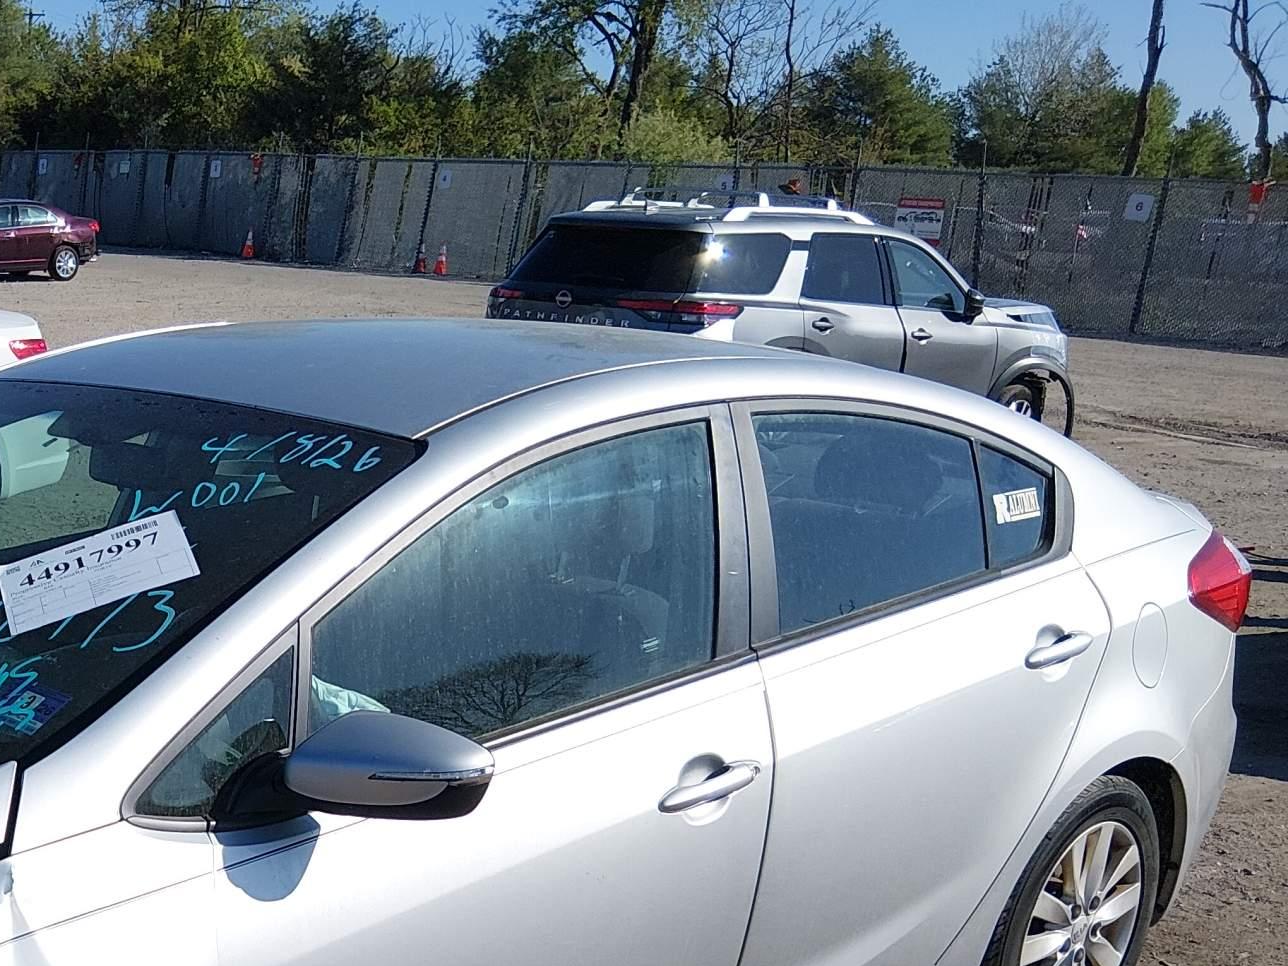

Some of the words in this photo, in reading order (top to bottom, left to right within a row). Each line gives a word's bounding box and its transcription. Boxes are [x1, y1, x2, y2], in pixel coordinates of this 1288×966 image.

[1135, 202, 1144, 212] 6
[503, 308, 631, 328] PATHFINDER
[19, 531, 158, 587] 44917997
